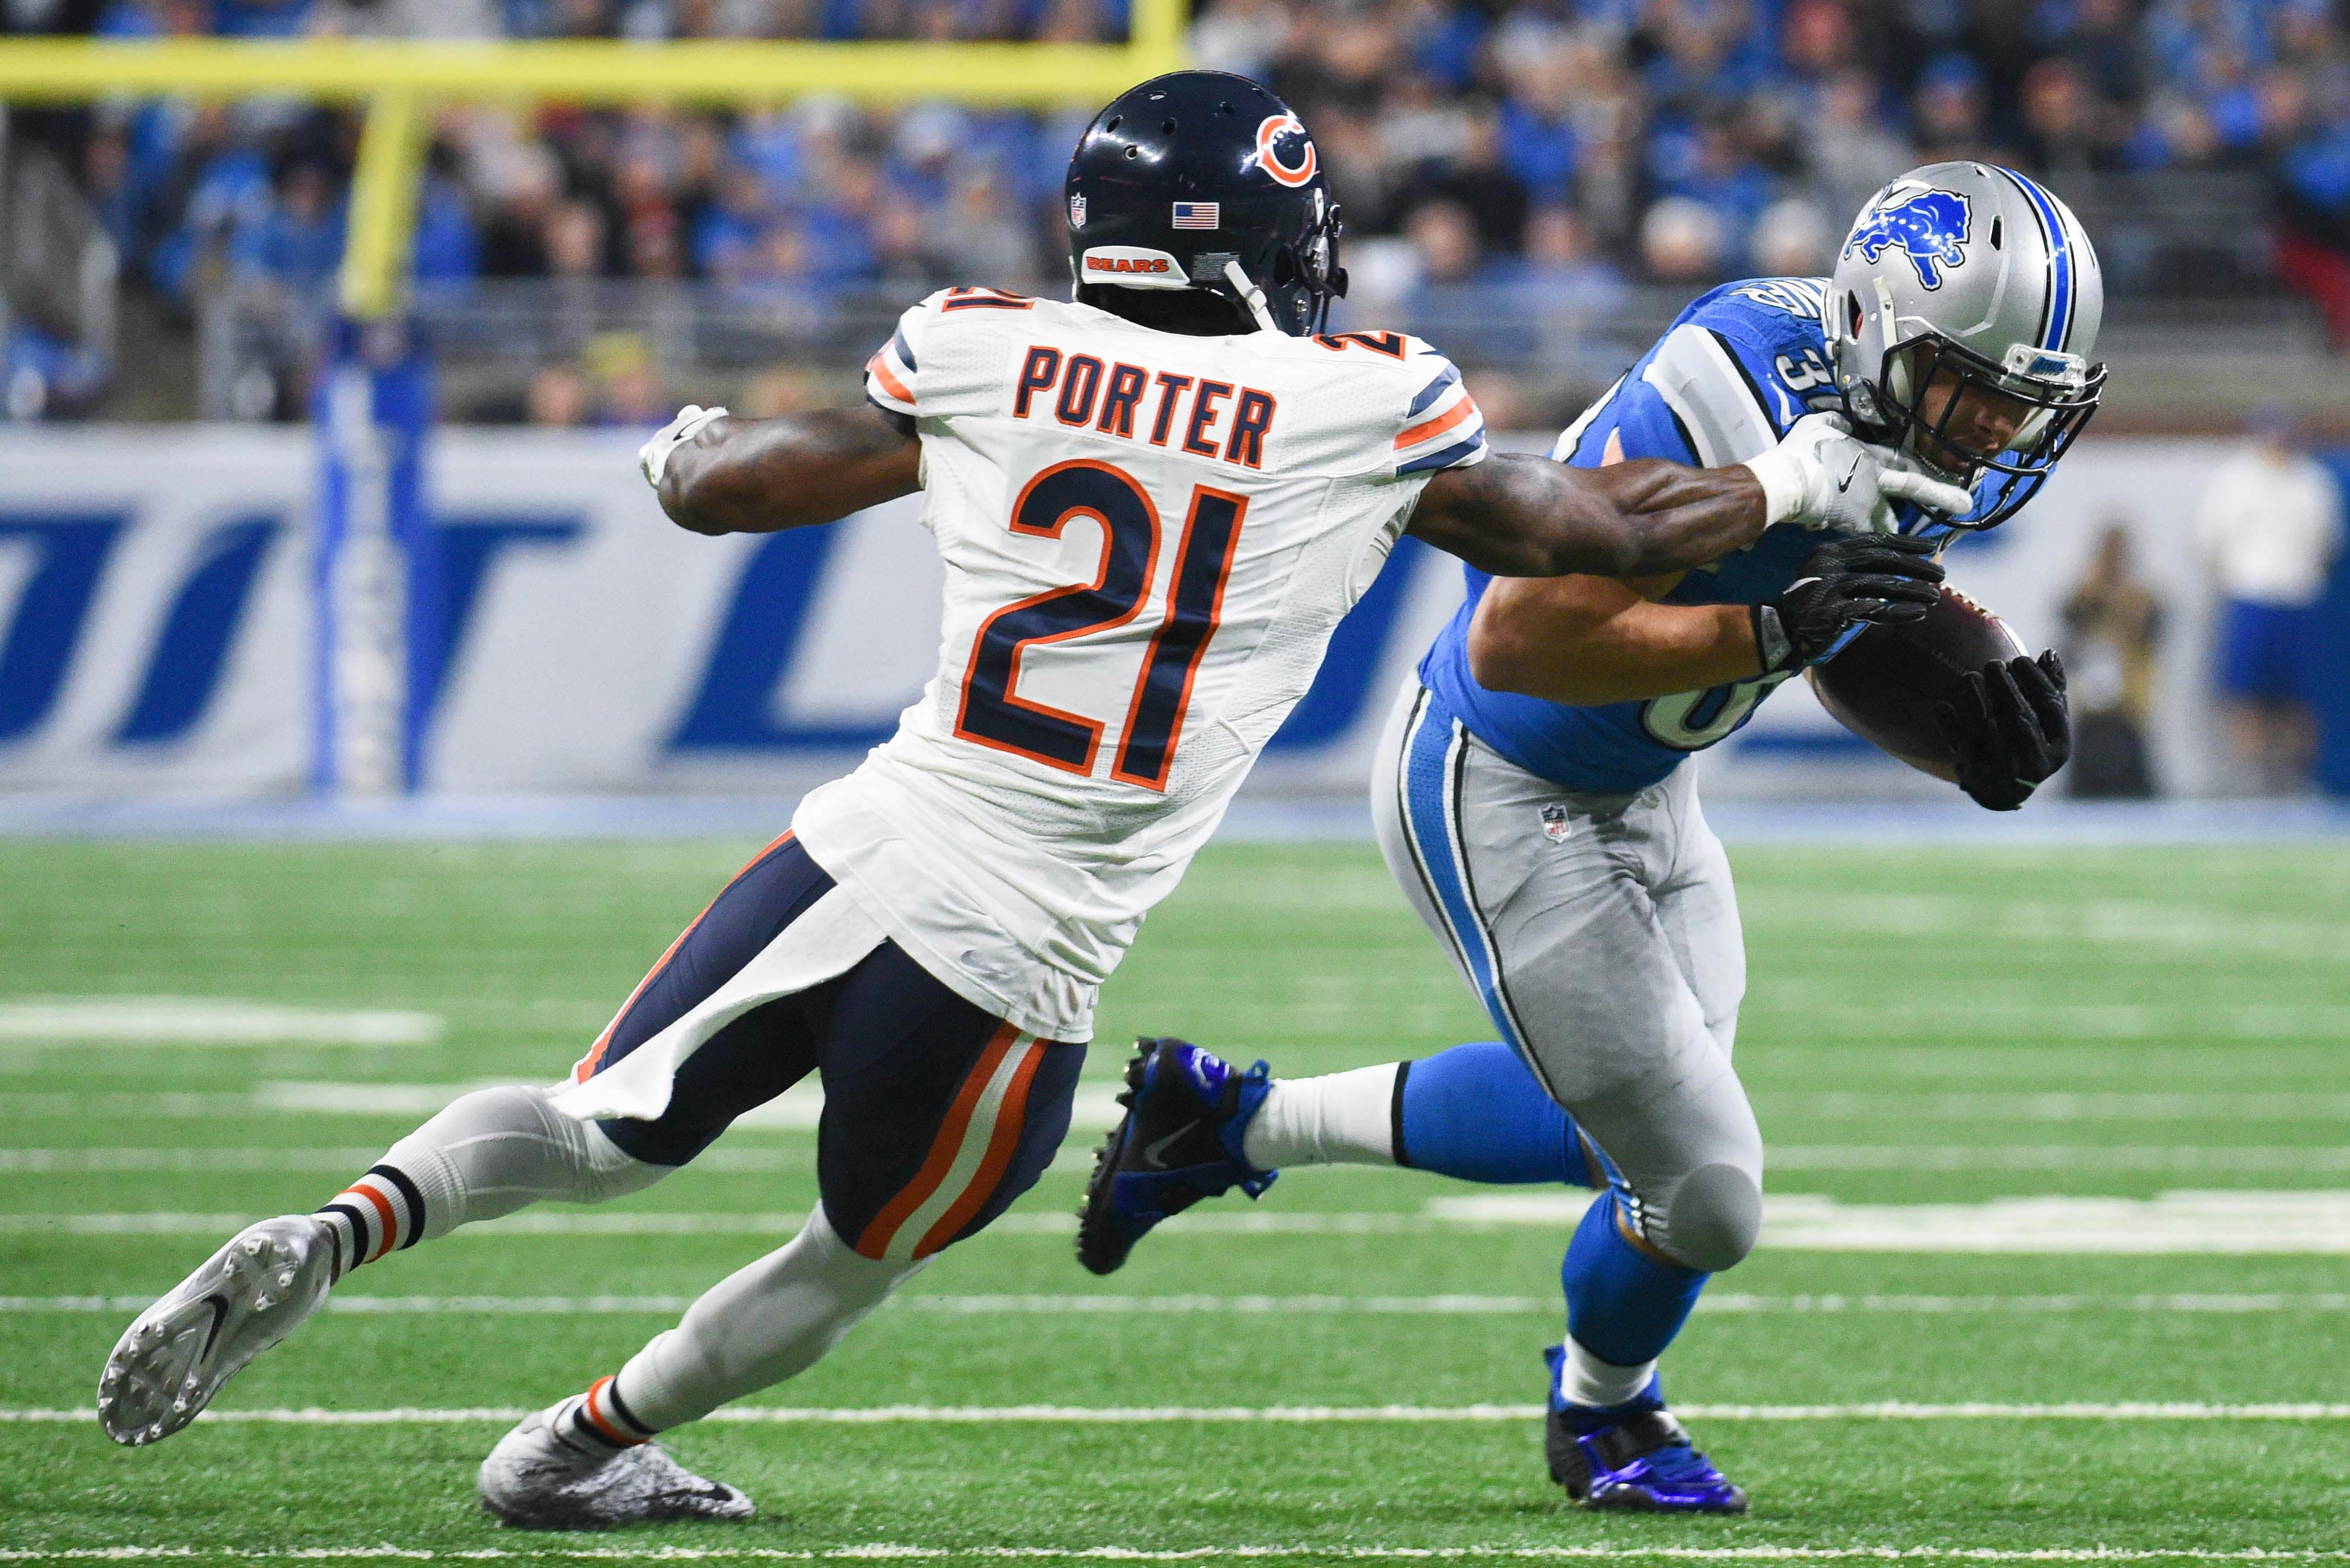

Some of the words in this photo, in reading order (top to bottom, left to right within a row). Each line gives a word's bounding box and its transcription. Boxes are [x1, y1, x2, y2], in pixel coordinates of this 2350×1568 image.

[1086, 256, 1170, 273] BEARS
[1013, 345, 1276, 470] PORTER
[1775, 347, 1843, 412] 3
[953, 458, 1250, 792] 21
